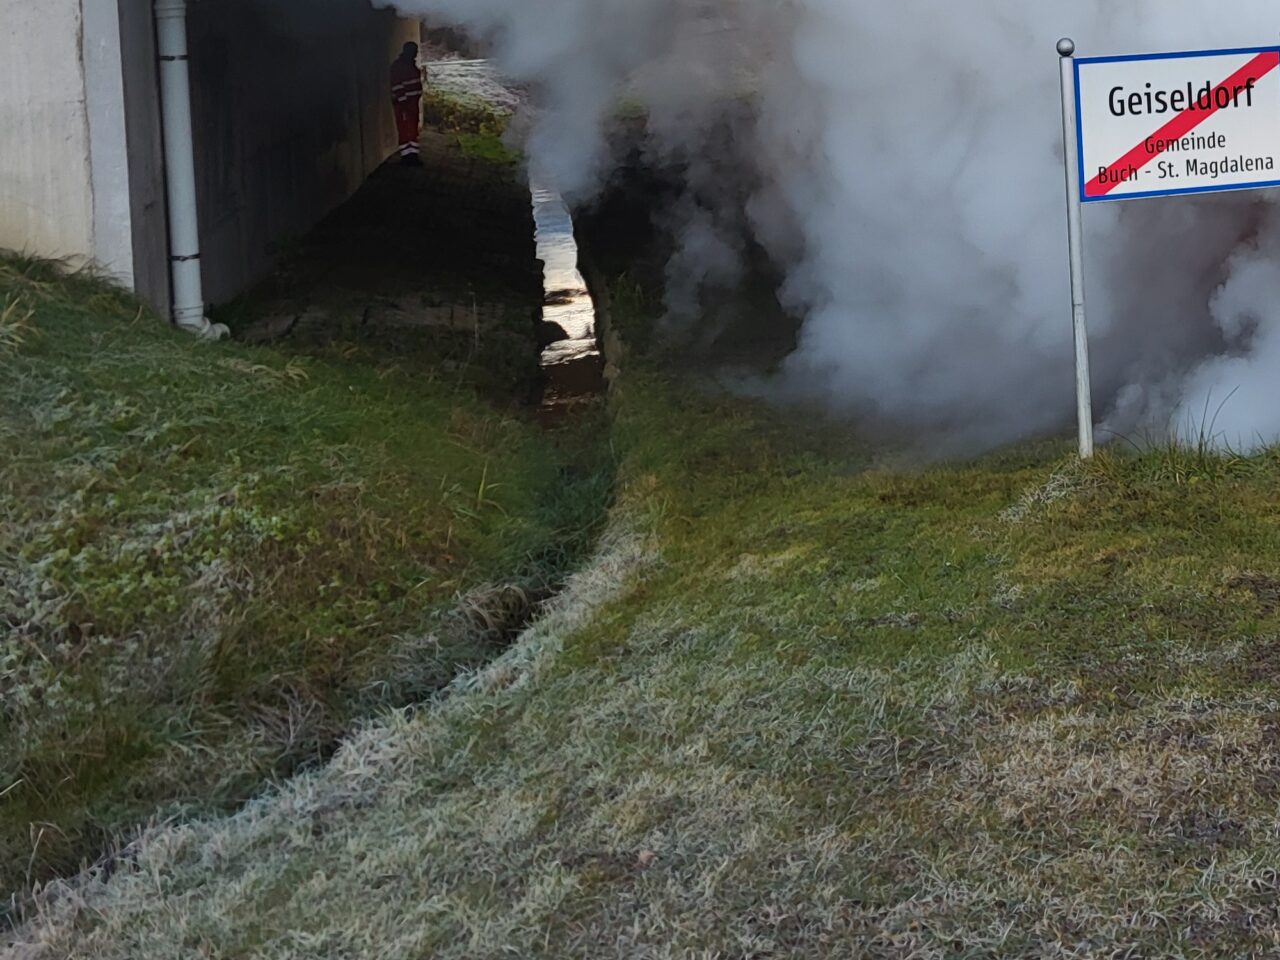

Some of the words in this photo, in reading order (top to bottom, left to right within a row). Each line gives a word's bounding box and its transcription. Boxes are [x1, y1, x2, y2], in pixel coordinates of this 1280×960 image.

[1108, 77, 1255, 117] Geiseldorf
[1144, 132, 1226, 154] Gemeinde
[1098, 164, 1138, 184] Buch
[1157, 160, 1180, 179] St.
[1186, 155, 1274, 178] Magdalena
